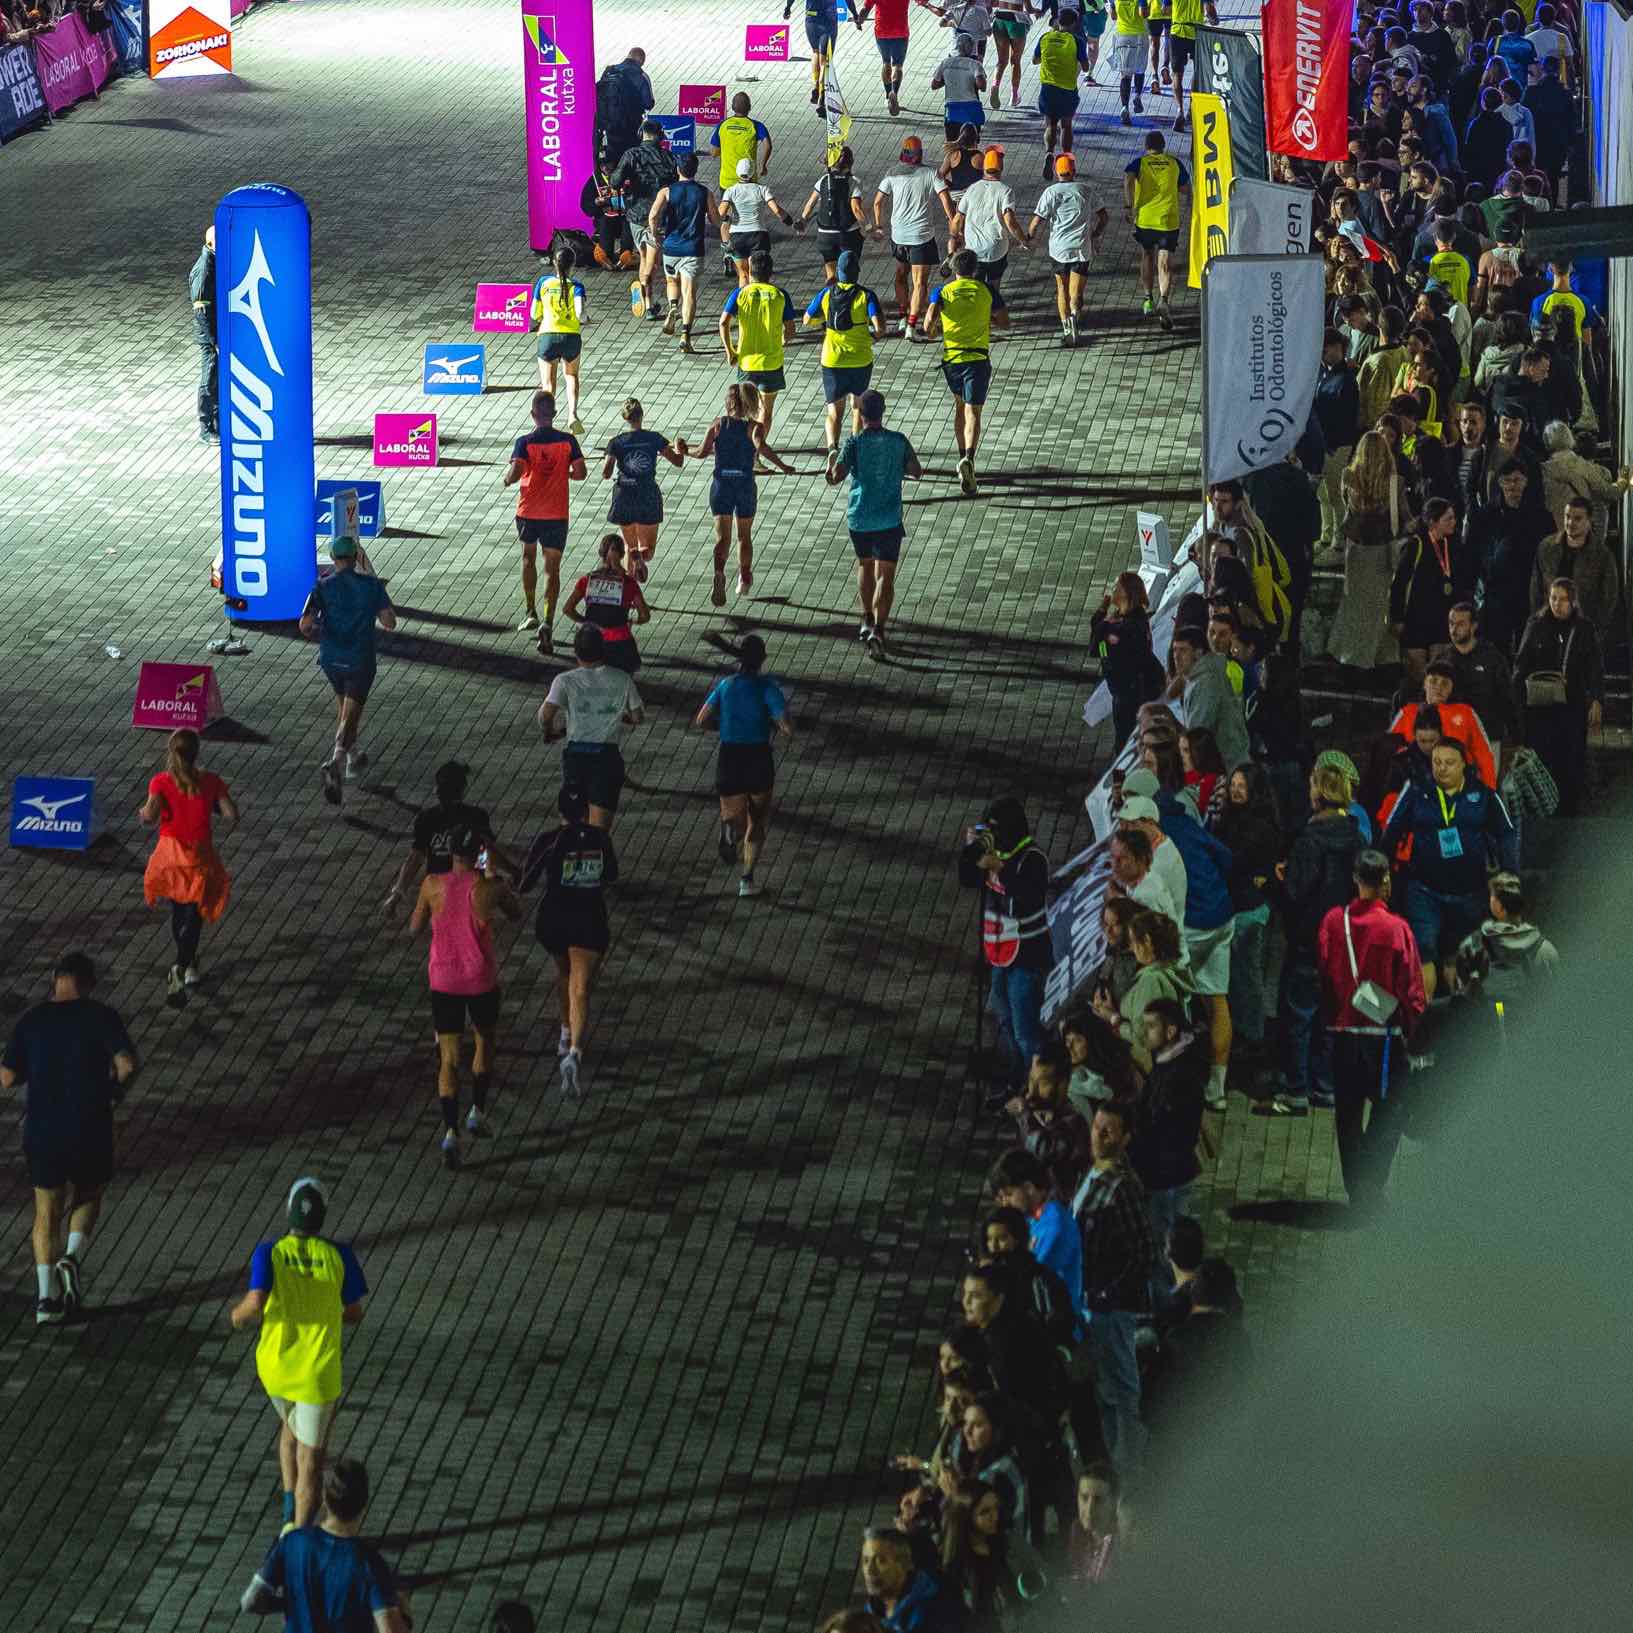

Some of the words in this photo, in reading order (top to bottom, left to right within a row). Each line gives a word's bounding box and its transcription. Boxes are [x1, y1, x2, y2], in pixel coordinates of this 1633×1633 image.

[156, 33, 228, 63] ZORIONAK!
[11, 74, 44, 119] ADE
[561, 67, 576, 115] kutxa
[539, 68, 562, 182] LABORAL
[479, 311, 524, 321] LABORAL
[1268, 270, 1288, 402] Odontológicos
[1250, 314, 1265, 402] Institutos
[379, 443, 430, 454] LABORAL
[141, 699, 198, 713] LABORAL
